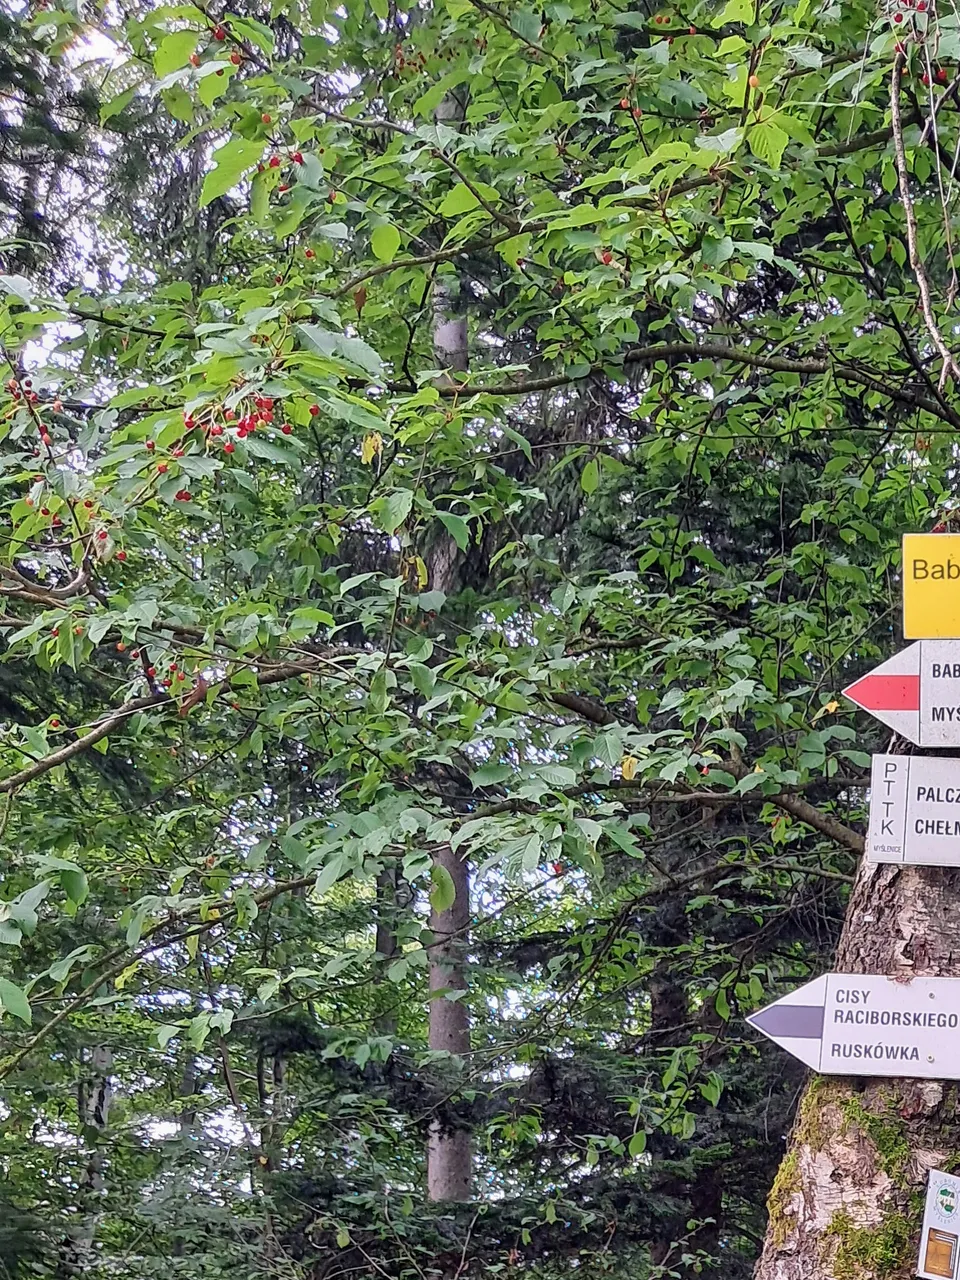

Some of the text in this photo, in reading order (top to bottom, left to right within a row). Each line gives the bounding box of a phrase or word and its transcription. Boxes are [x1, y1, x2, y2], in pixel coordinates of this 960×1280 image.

[836, 989, 871, 1004] CISY
[834, 1010, 958, 1029] RACIBORSKIEGO
[831, 1042, 920, 1061] RUSKÓWKA
